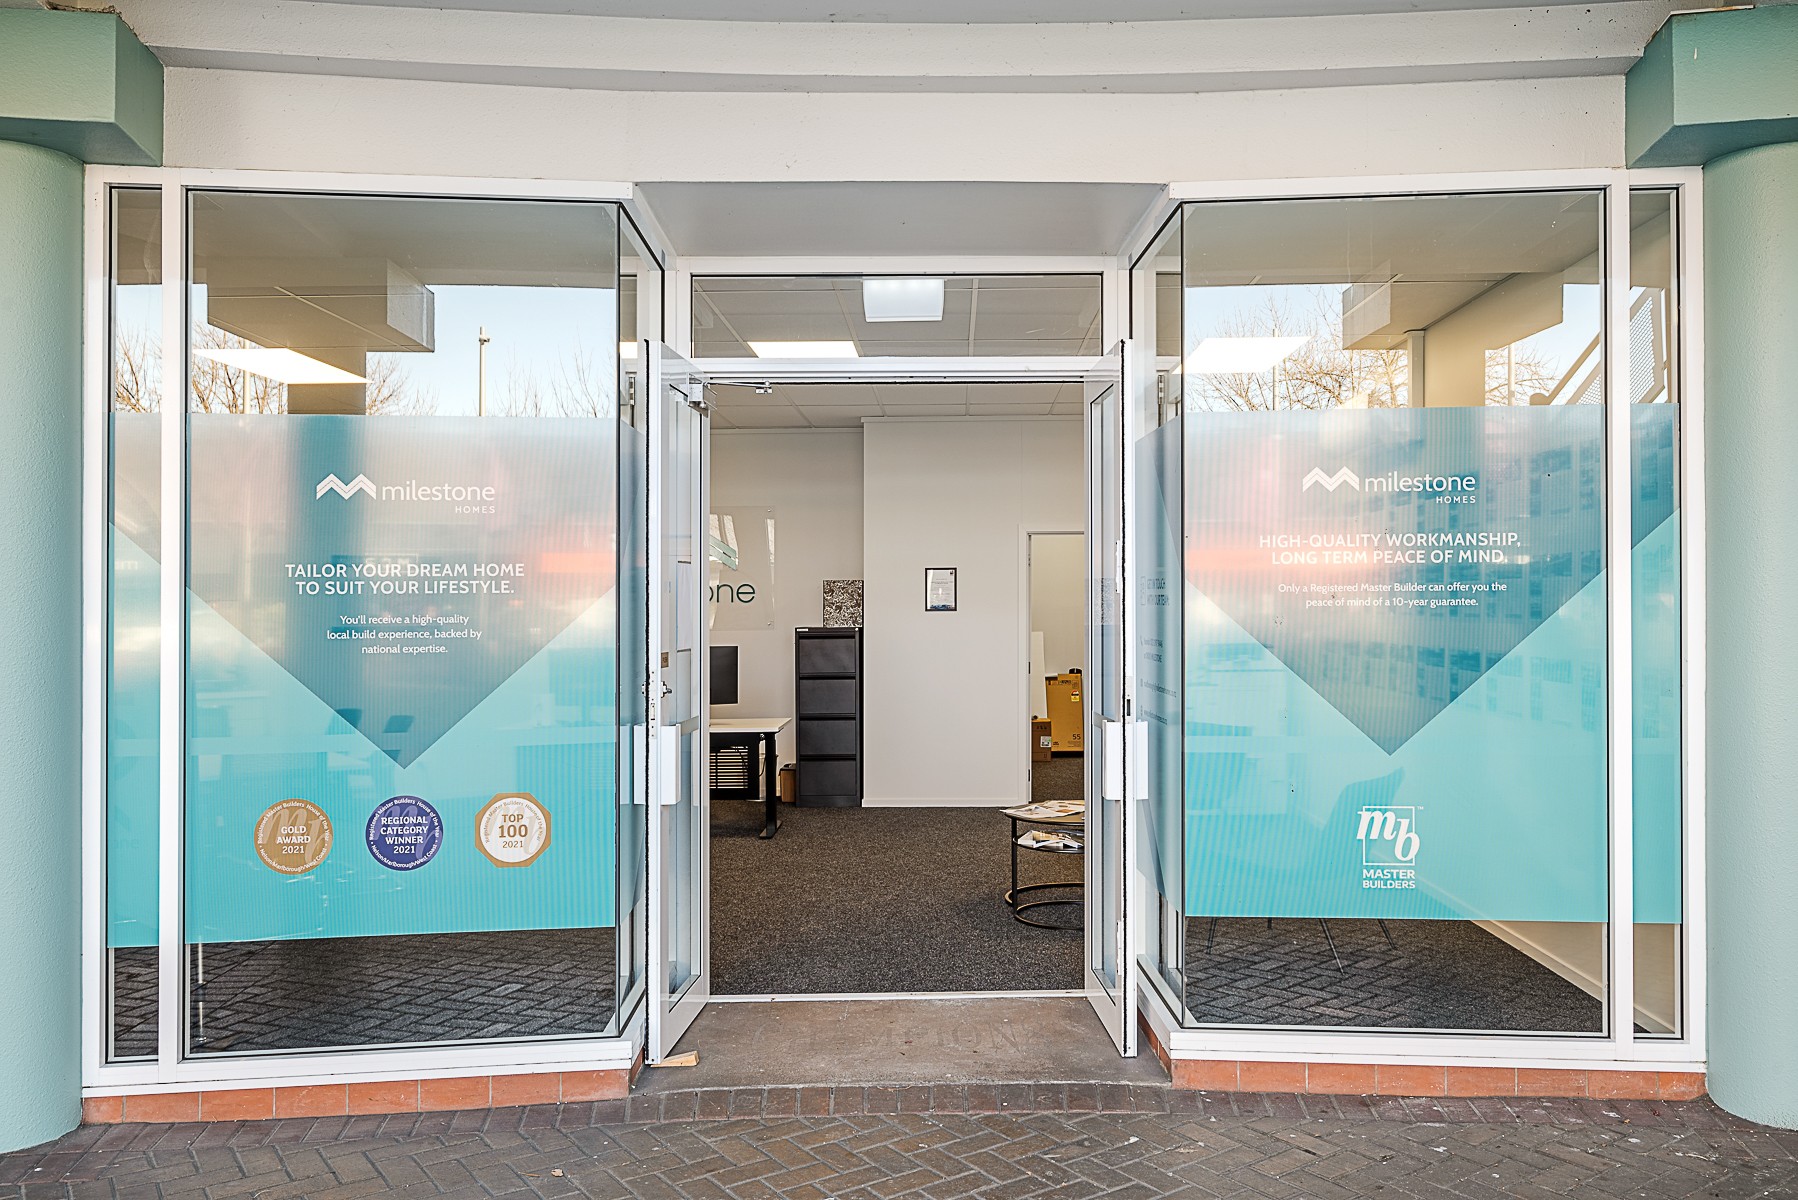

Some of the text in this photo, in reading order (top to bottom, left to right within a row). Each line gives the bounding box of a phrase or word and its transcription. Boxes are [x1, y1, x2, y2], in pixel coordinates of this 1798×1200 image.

[1365, 471, 1476, 492] milestone
[382, 479, 495, 501] milestone
[1436, 495, 1476, 504] HOMES
[455, 506, 496, 514] HOMES
[1259, 532, 1521, 548] HIGH-QUALITY WORKMANSHIP,
[1272, 550, 1508, 565] LONG TERM PEACE OF MIND.
[285, 563, 525, 578] TAILOR YOUR DREAM HOME
[295, 580, 515, 595] TO SUIT YOUR LIFESTYLE.
[1278, 583, 1300, 594] Only
[1310, 582, 1358, 594] Registered
[1361, 583, 1391, 592] Master
[1394, 582, 1426, 592] Builder
[1428, 584, 1444, 592] can
[1446, 582, 1469, 591] offer
[1472, 584, 1489, 593] you
[1491, 581, 1507, 591] the
[1305, 600, 1333, 609] peace
[1335, 597, 1344, 606] of
[1347, 597, 1371, 606] mind
[1373, 597, 1383, 606] of
[1392, 597, 1428, 608] 10-year
[1430, 598, 1478, 608] guarantee.
[340, 615, 366, 625] You'll
[368, 615, 402, 625] receive
[412, 614, 469, 626] high-quality
[327, 629, 482, 641] local build experience, backed by
[361, 644, 448, 655] national expertise.
[257, 817, 268, 844] Registered
[266, 805, 283, 818] Master
[306, 804, 321, 817] House
[369, 814, 380, 840] Registered
[378, 801, 394, 815] Master
[417, 801, 431, 813] House
[381, 816, 428, 825] REGIONAL
[502, 814, 524, 823] TOP
[281, 825, 307, 834] GOLD
[380, 825, 428, 835] CATEGORY
[498, 824, 528, 838] 100
[276, 835, 311, 844] AWARD
[385, 836, 423, 844] WINNER
[1356, 810, 1420, 861] mb
[282, 845, 305, 854] 2021
[393, 845, 415, 854] 2021
[502, 840, 523, 848] 2021
[1363, 869, 1415, 879] MASTER
[1363, 880, 1416, 889] BUILDERS
